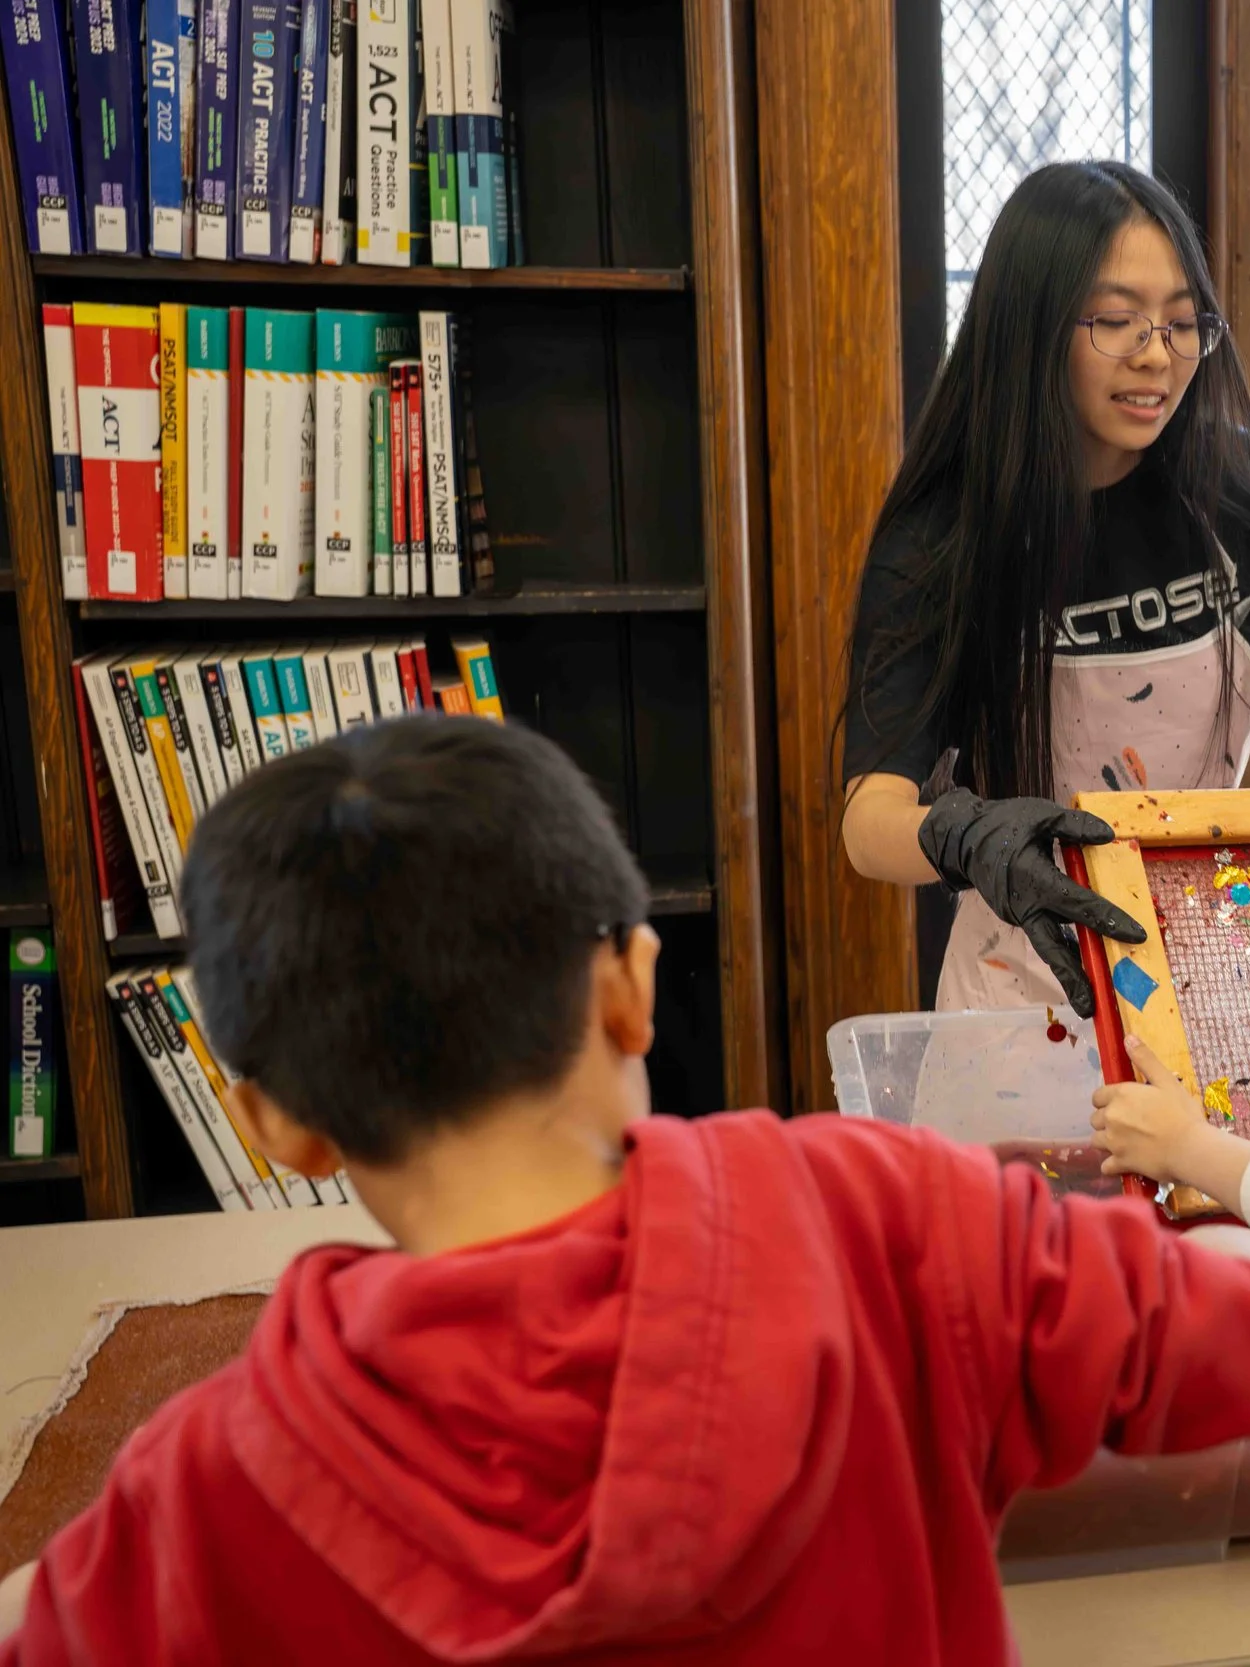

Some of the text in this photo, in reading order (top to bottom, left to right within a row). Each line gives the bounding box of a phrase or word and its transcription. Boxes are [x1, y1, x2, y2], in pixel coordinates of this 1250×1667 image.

[368, 44, 398, 58] 1,523
[152, 39, 175, 142] ACT 2022
[301, 68, 314, 104] ACT
[369, 62, 397, 140] ACT
[252, 30, 274, 195] 10 ACT PRACTICE
[370, 145, 382, 217] Questions
[387, 150, 398, 209] Practice
[42, 196, 65, 207] CCP
[246, 200, 266, 210] CCP
[163, 338, 178, 443] PSAT/NMSQT
[427, 353, 442, 392] 575+
[102, 395, 120, 455] ACT
[433, 452, 450, 546] PSAT/NMSQ
[378, 511, 387, 535] ACT
[195, 546, 214, 556] CCP
[255, 546, 275, 557] CCP
[329, 541, 349, 550] CCP
[122, 698, 137, 720] STEPS
[164, 695, 178, 719] STEPS
[212, 693, 225, 716] STEPS
[241, 728, 251, 748] SAT
[264, 731, 284, 756] AP
[22, 983, 43, 1117] School Diction
[171, 1085, 194, 1124] Biology
[193, 1079, 218, 1123] Statistics
